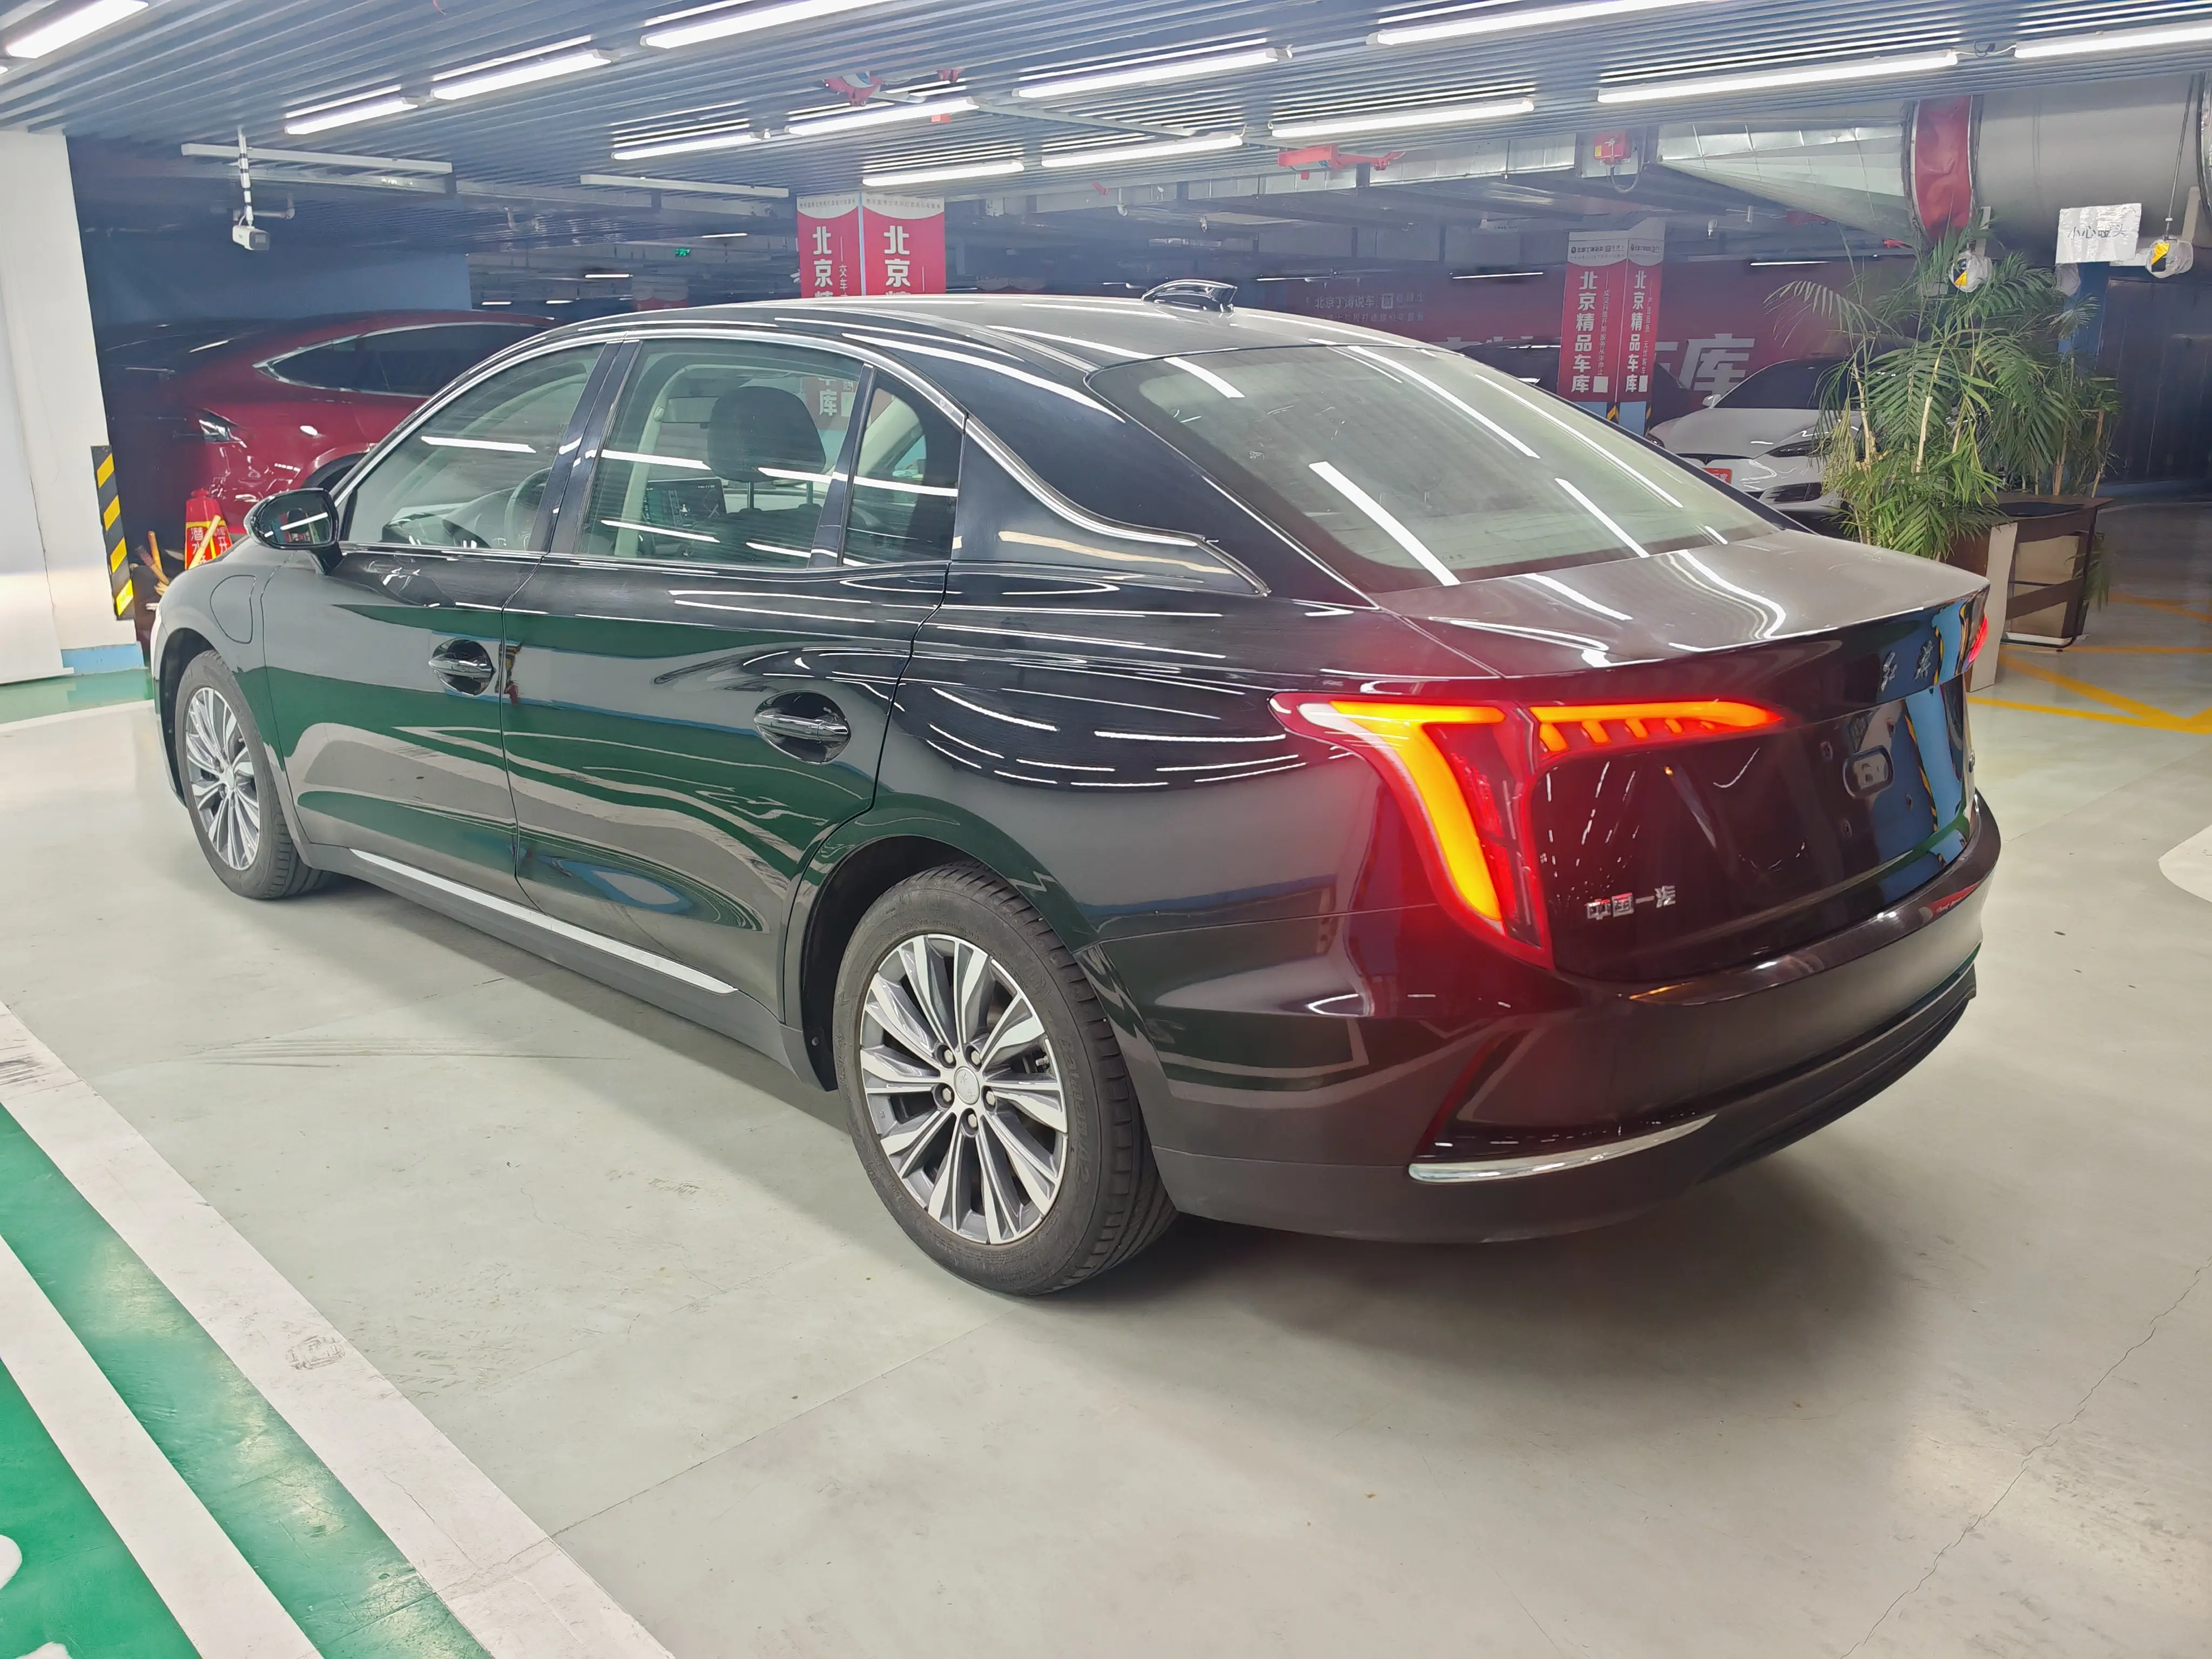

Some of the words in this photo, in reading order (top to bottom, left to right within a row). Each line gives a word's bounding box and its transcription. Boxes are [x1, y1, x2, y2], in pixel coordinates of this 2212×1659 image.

[813, 226, 833, 297] 北京
[884, 225, 911, 295] 北京
[1571, 271, 1598, 393] 北京精品车库
[1626, 271, 1647, 393] 北京精品车库
[1586, 885, 1676, 920] 中国一汽
